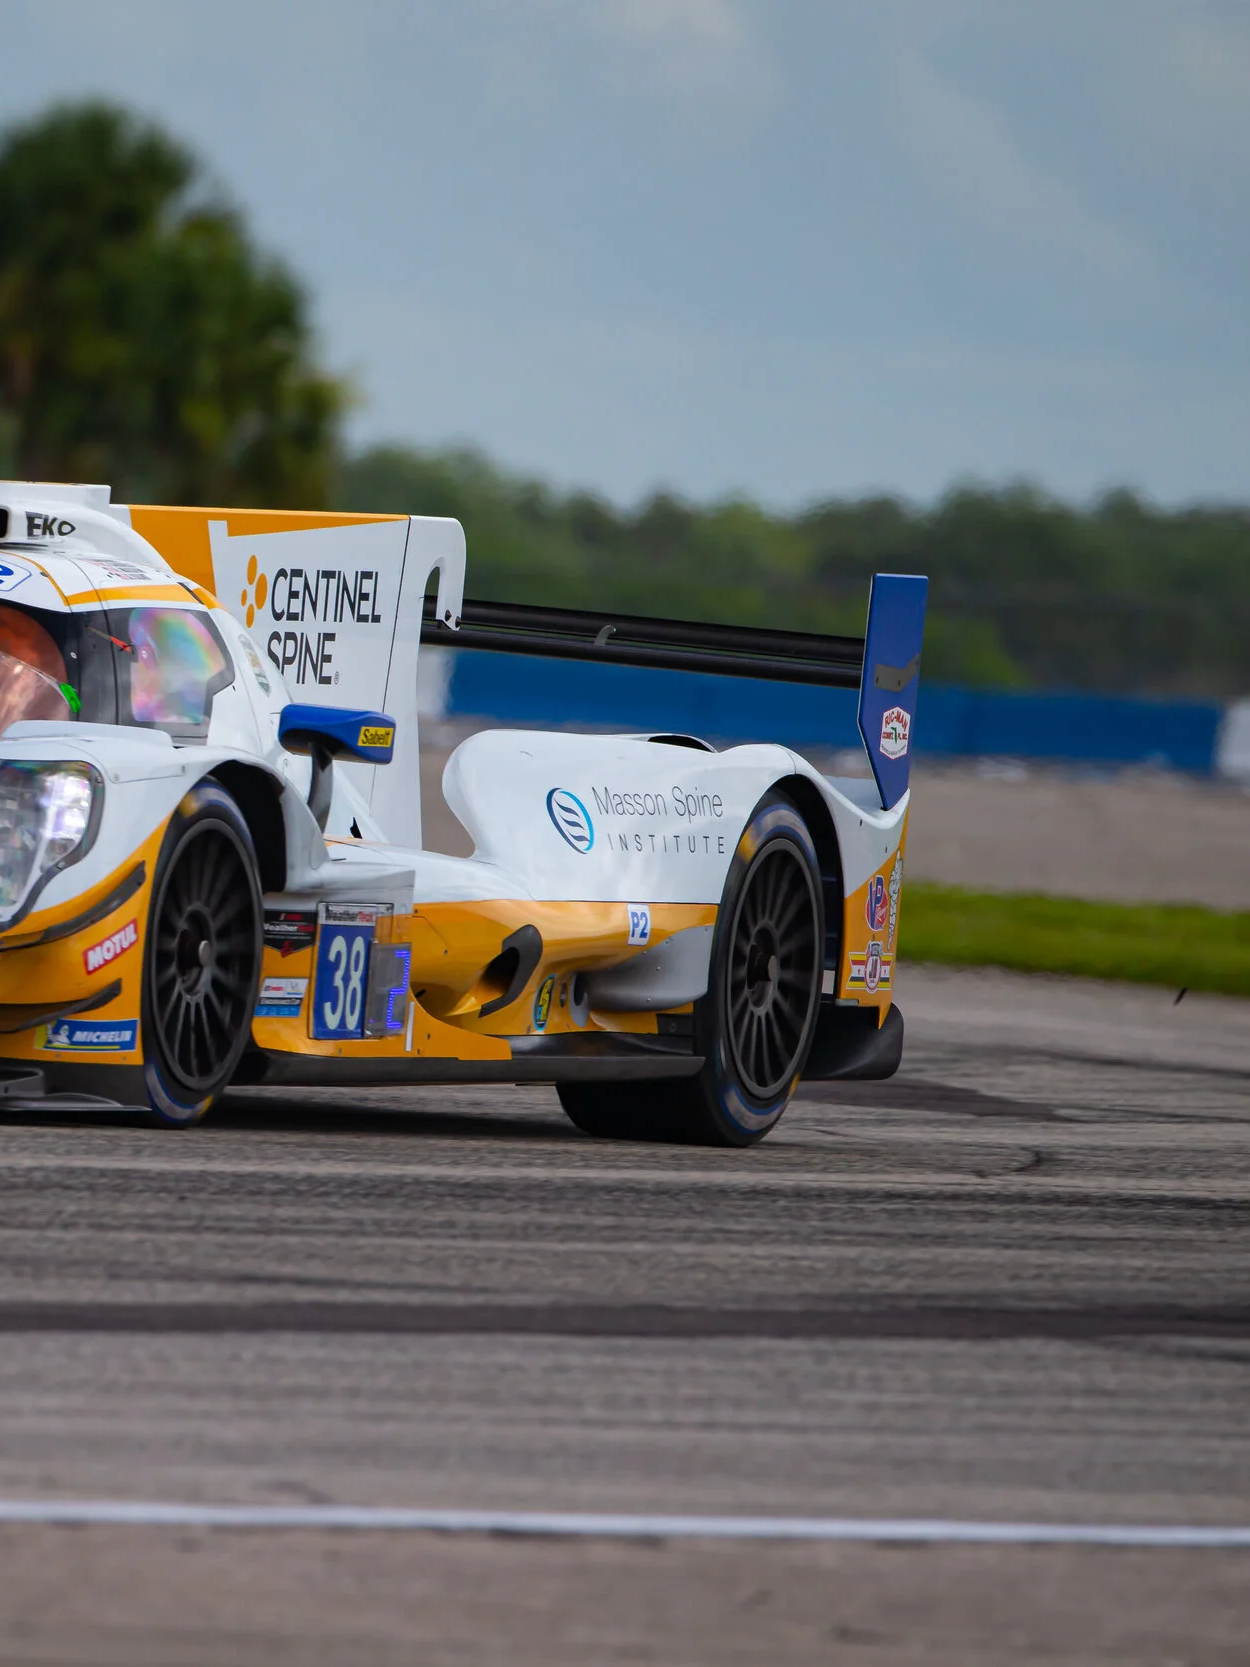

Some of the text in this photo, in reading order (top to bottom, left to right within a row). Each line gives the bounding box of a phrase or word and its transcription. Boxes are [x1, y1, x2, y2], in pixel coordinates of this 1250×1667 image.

[271, 568, 381, 623] CENTINEL
[267, 631, 336, 685] SPINE
[592, 786, 723, 824] Masson Spine
[607, 833, 725, 854] INSTITUTE
[630, 911, 649, 939] P2
[87, 923, 137, 971] MOTUL
[324, 935, 365, 1030] 38
[72, 1030, 132, 1042] MICHELIN
